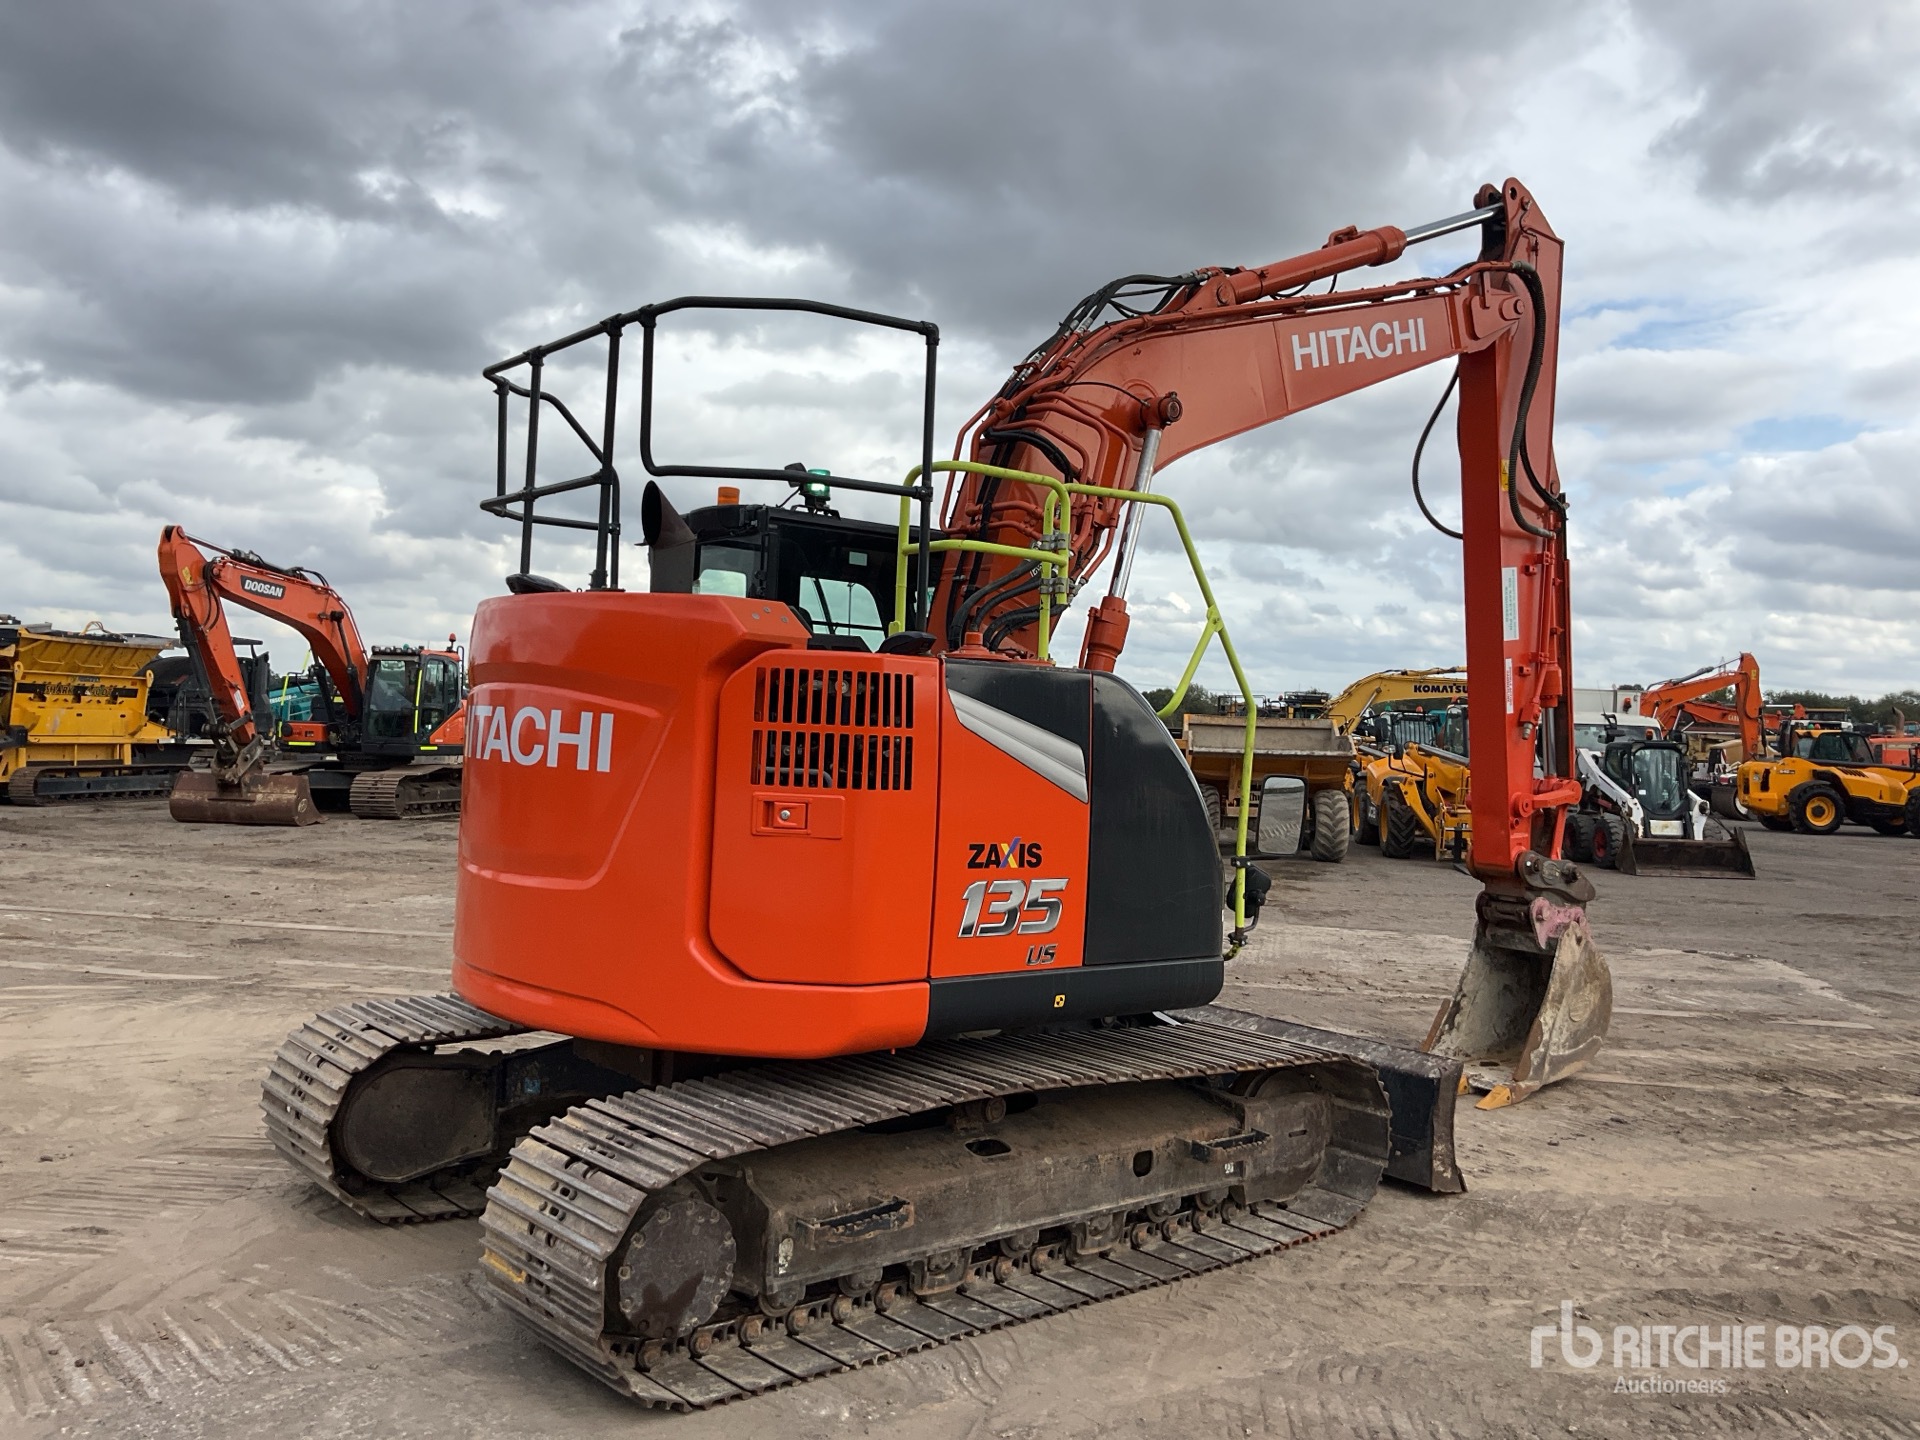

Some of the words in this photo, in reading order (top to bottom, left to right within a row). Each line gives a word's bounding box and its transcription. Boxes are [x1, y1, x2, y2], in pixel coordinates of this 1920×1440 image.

[1291, 317, 1427, 371] HITACHI
[244, 579, 283, 598] DOOSAN
[465, 705, 614, 773] ITACHI
[967, 836, 1043, 869] ZAXIS
[958, 878, 1070, 938] 135
[1026, 943, 1058, 966] US
